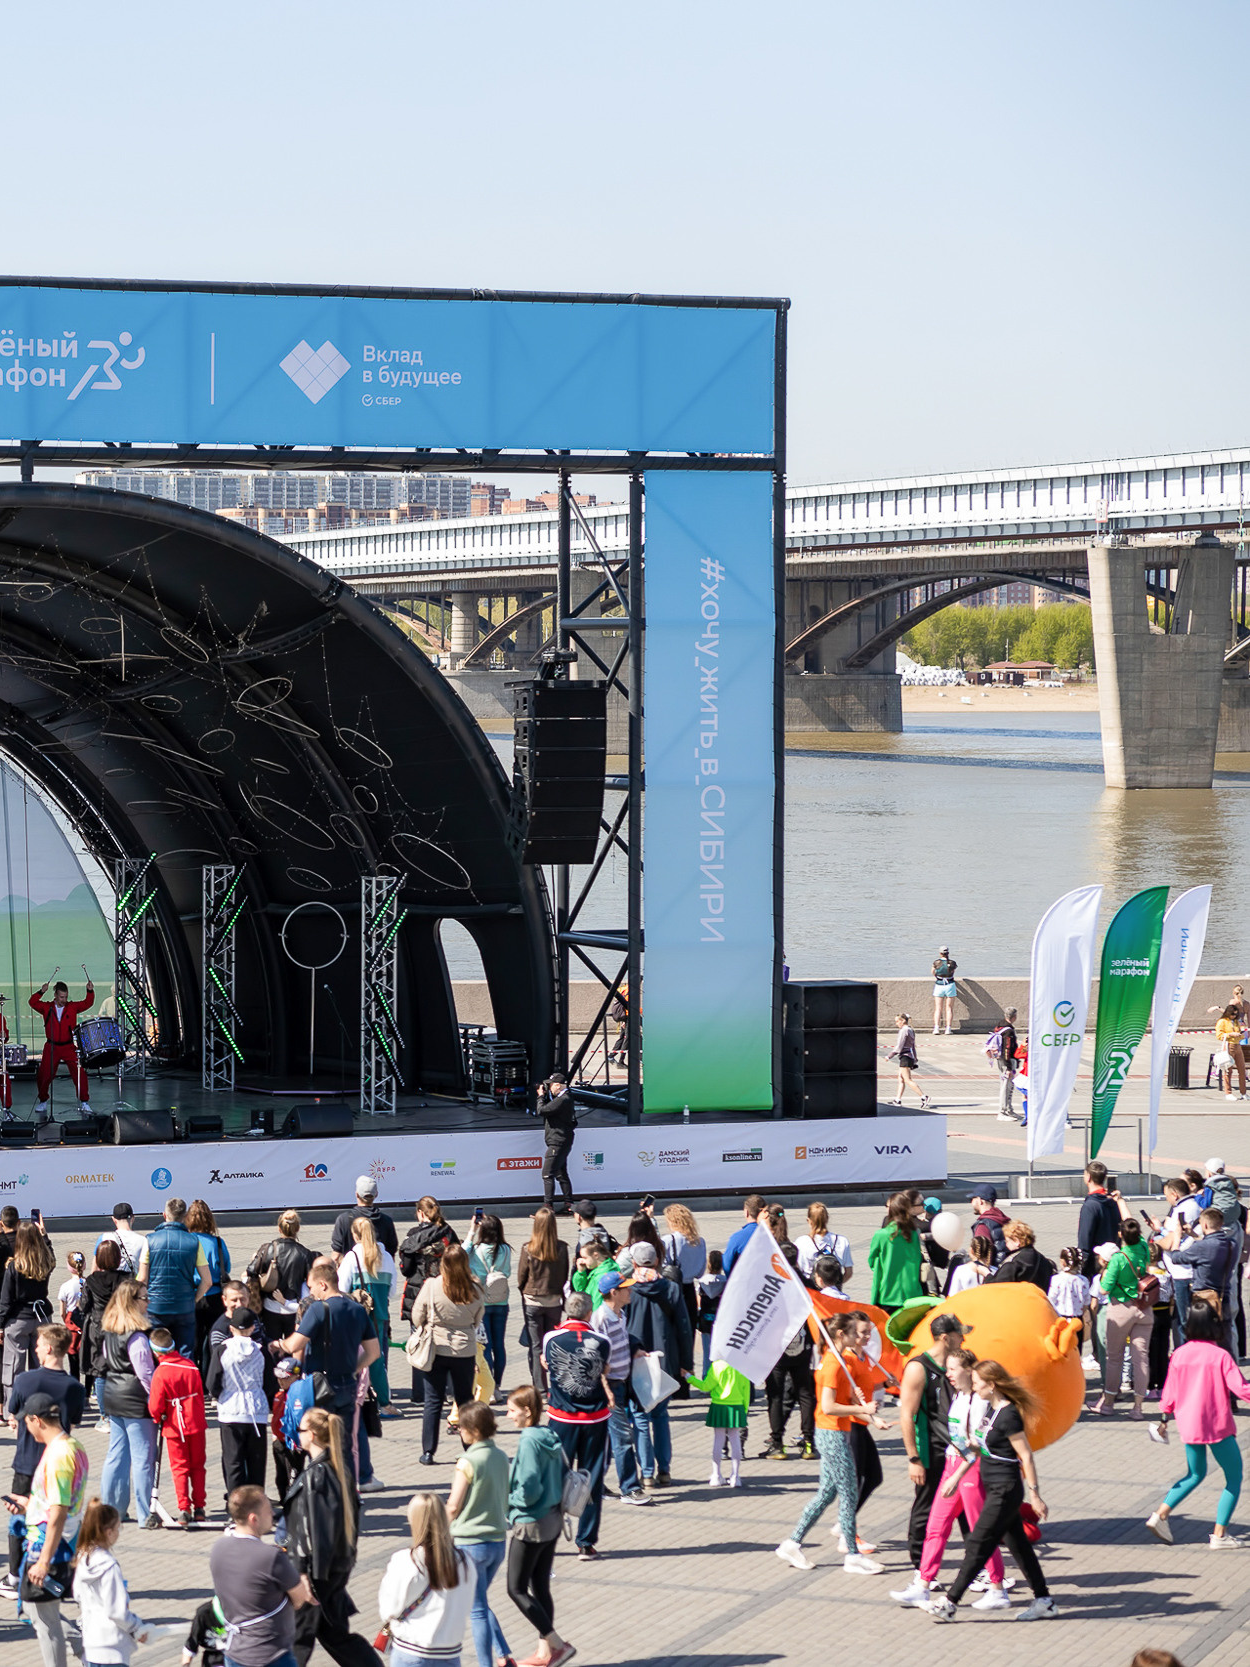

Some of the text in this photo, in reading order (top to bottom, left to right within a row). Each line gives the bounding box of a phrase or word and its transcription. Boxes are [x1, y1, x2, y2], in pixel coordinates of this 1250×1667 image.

[363, 345, 423, 366] Вклад
[362, 365, 462, 388] в будущее
[375, 396, 402, 405] СБЕР
[1111, 957, 1150, 968] зелёный
[1109, 966, 1150, 978] марафон
[1041, 1033, 1081, 1047] СБЕР
[659, 1149, 690, 1157] ДАМСКИЙ
[874, 1145, 912, 1154] VIRA
[65, 1174, 115, 1183] ORMATEK
